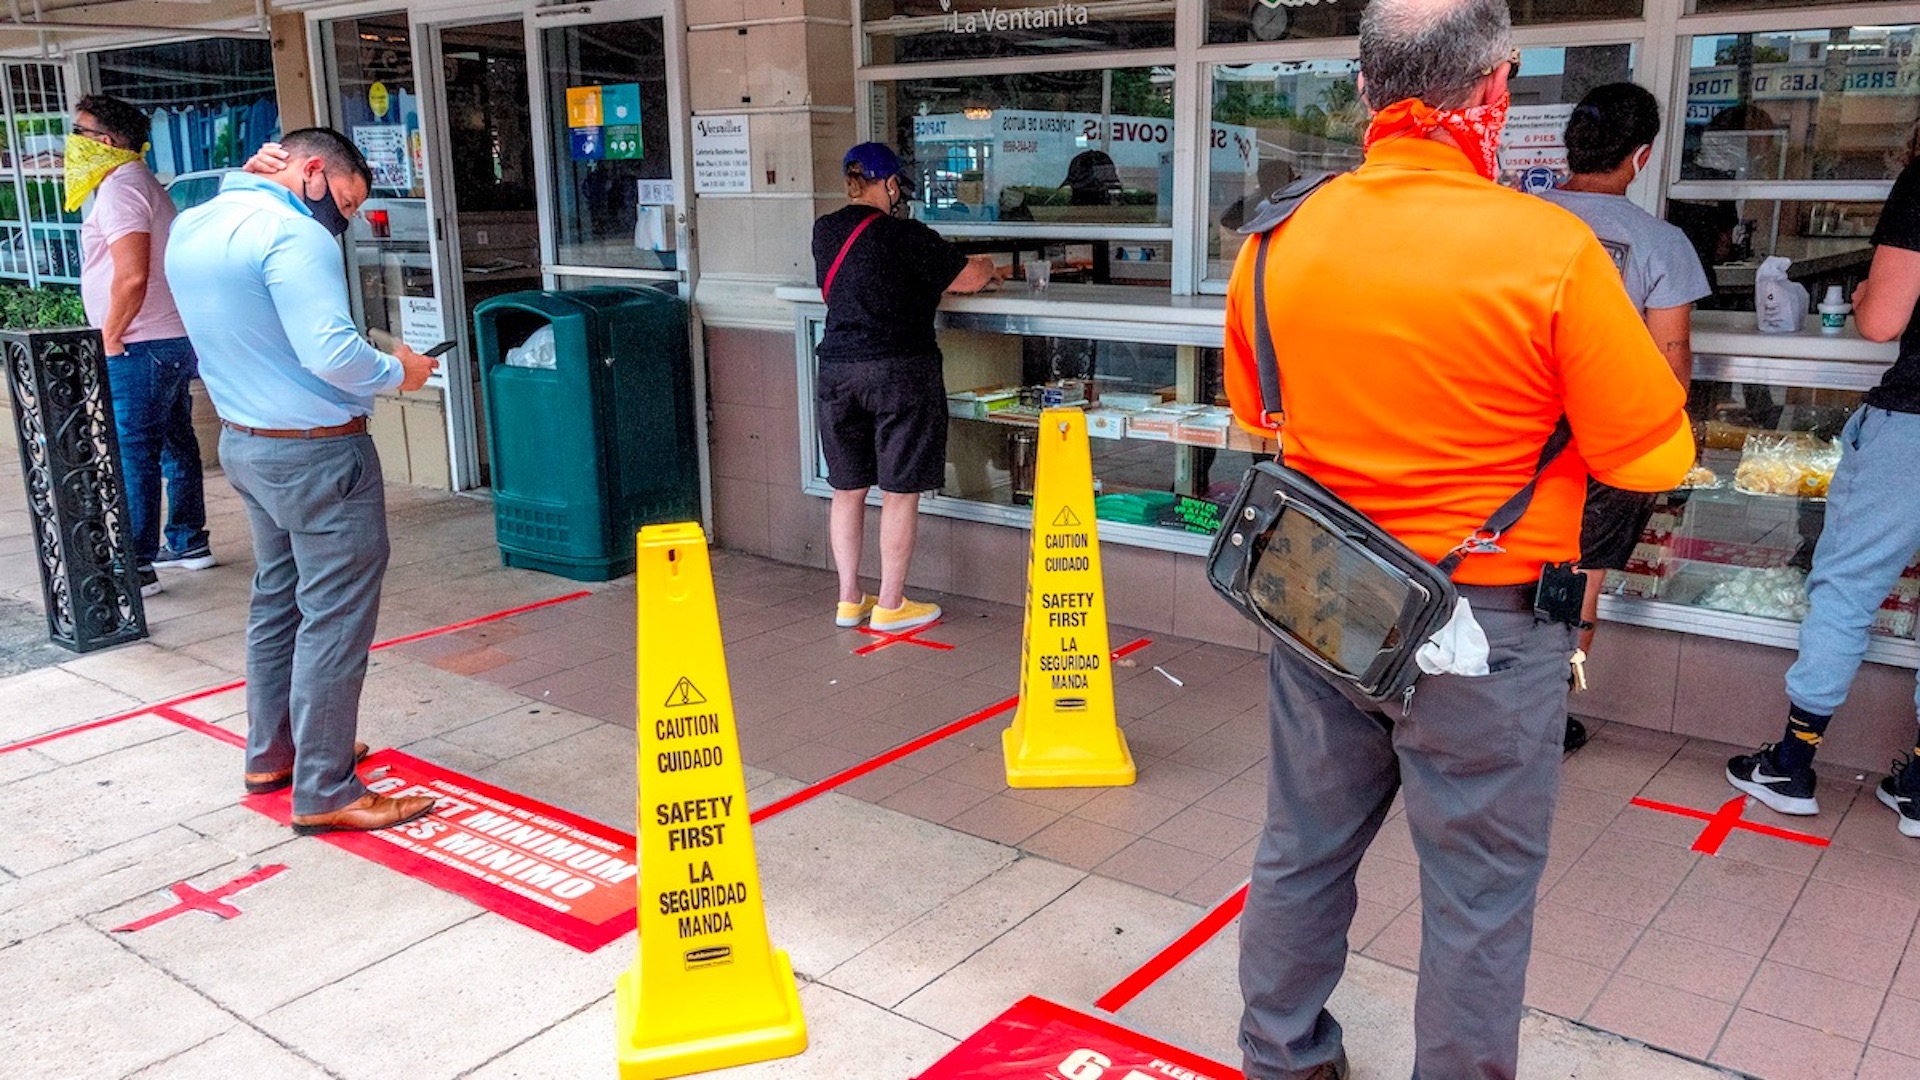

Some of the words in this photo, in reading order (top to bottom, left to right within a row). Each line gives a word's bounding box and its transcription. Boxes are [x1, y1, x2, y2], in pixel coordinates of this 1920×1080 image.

[953, 10, 976, 34] La
[982, 3, 1088, 32] Ventanita
[1524, 134, 1531, 143] 6
[1534, 134, 1556, 142] PIES
[1505, 158, 1531, 166] USEN
[1533, 157, 1567, 165] MASCA
[1045, 534, 1088, 549] CAUTION
[1045, 556, 1089, 571] CUIDADO
[1042, 592, 1094, 609] SAFETY
[1049, 612, 1087, 627] FIRST
[1061, 637, 1077, 652] LA
[1040, 655, 1100, 671] SEGURIDAD
[1052, 675, 1088, 690] MANDA
[655, 713, 719, 741] CAUTION
[657, 746, 723, 773] CUIDADO
[510, 808, 535, 820] THE
[656, 795, 733, 826] SAFETY
[366, 777, 407, 794] 6
[459, 810, 638, 884] MINIMUM
[669, 824, 725, 851] FIRST
[689, 861, 714, 884] LA
[659, 881, 747, 916] SEGURIDAD
[678, 911, 734, 939] MANDA
[1057, 1048, 1112, 1080] 6
